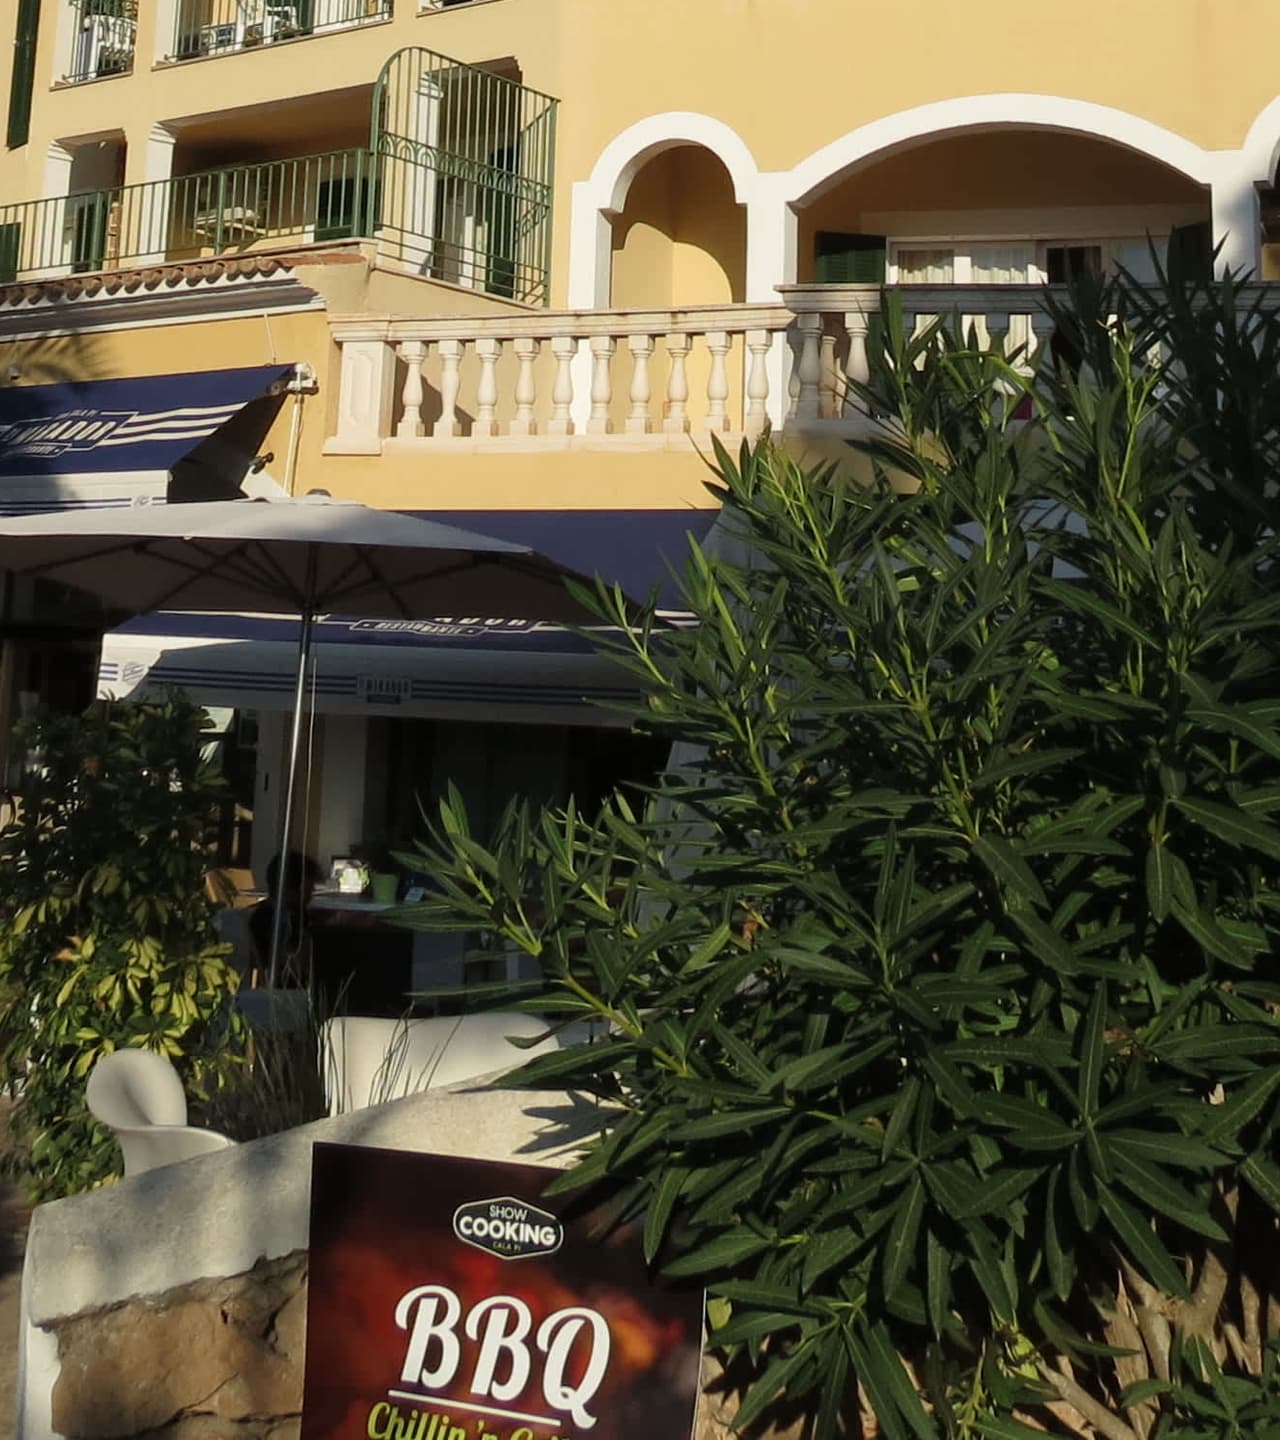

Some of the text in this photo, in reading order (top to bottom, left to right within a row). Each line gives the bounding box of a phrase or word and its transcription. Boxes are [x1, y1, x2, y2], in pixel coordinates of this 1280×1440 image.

[489, 1205, 528, 1220] SHOW
[459, 1216, 556, 1246] COOKING
[394, 1284, 611, 1429] BBQ
